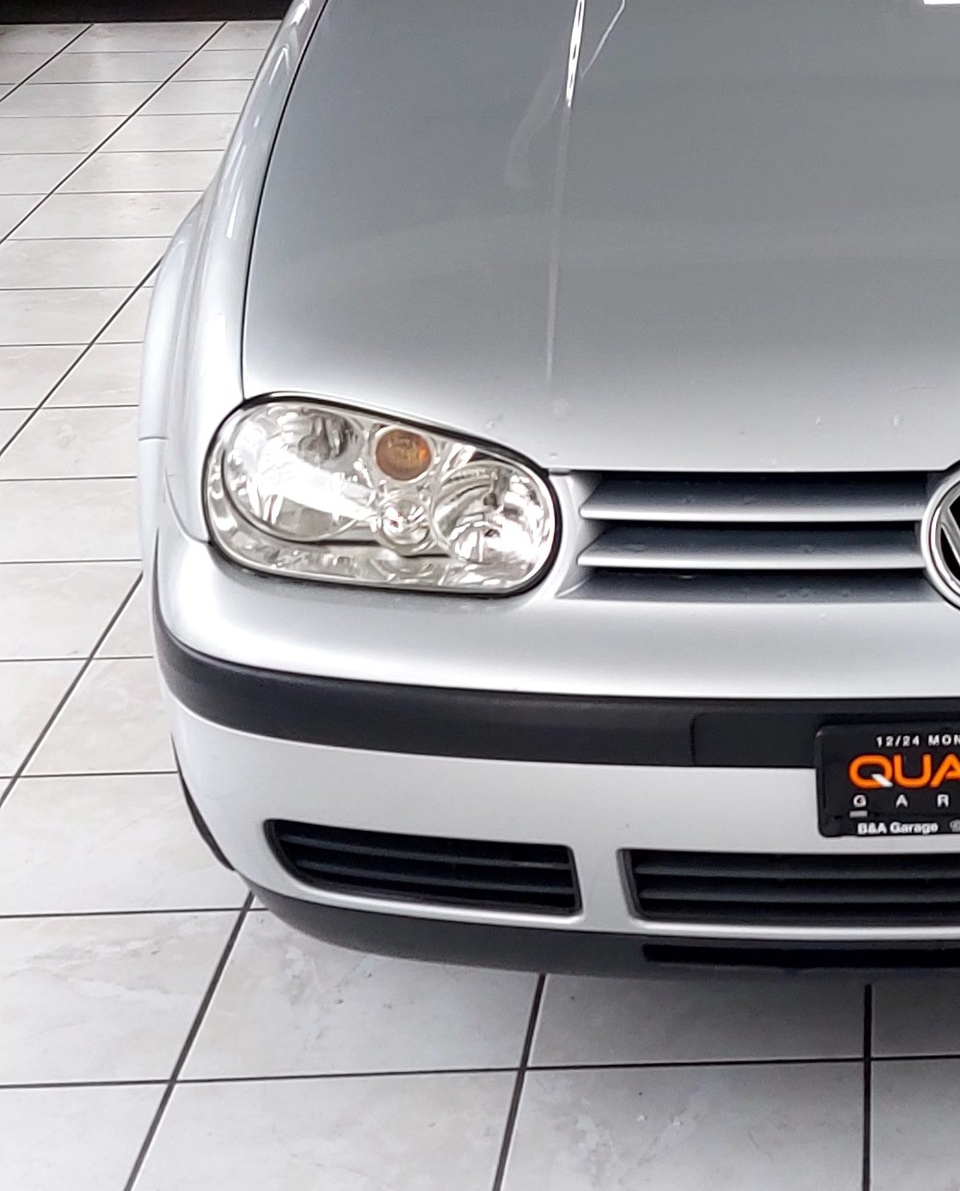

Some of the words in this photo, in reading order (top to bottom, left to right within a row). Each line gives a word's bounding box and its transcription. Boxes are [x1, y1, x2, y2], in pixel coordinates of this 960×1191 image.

[876, 735, 920, 748] 12/24
[857, 822, 888, 835] B&A
[890, 821, 939, 835] Garage
